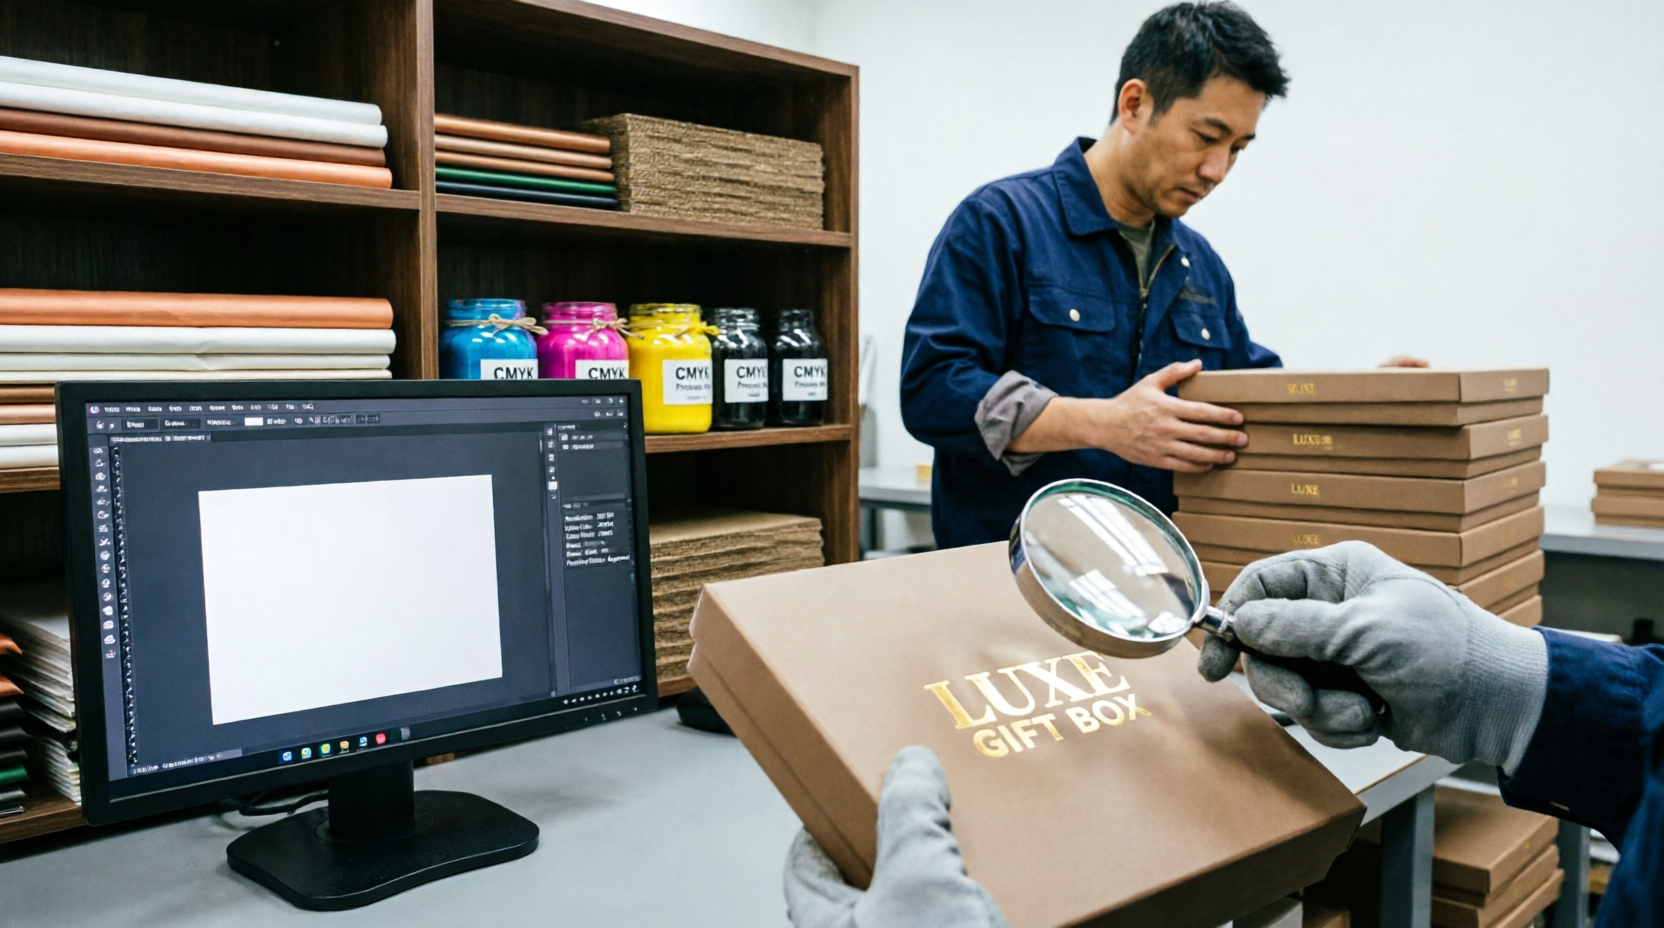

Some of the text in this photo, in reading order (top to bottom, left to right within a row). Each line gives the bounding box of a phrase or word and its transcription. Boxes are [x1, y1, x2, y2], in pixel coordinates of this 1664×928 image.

[494, 367, 533, 379] CMYK
[588, 367, 625, 379] CMYK
[1291, 483, 1319, 496] LUXE
[923, 650, 1131, 730] LUXE
[973, 693, 1152, 758] GIFT BOX
